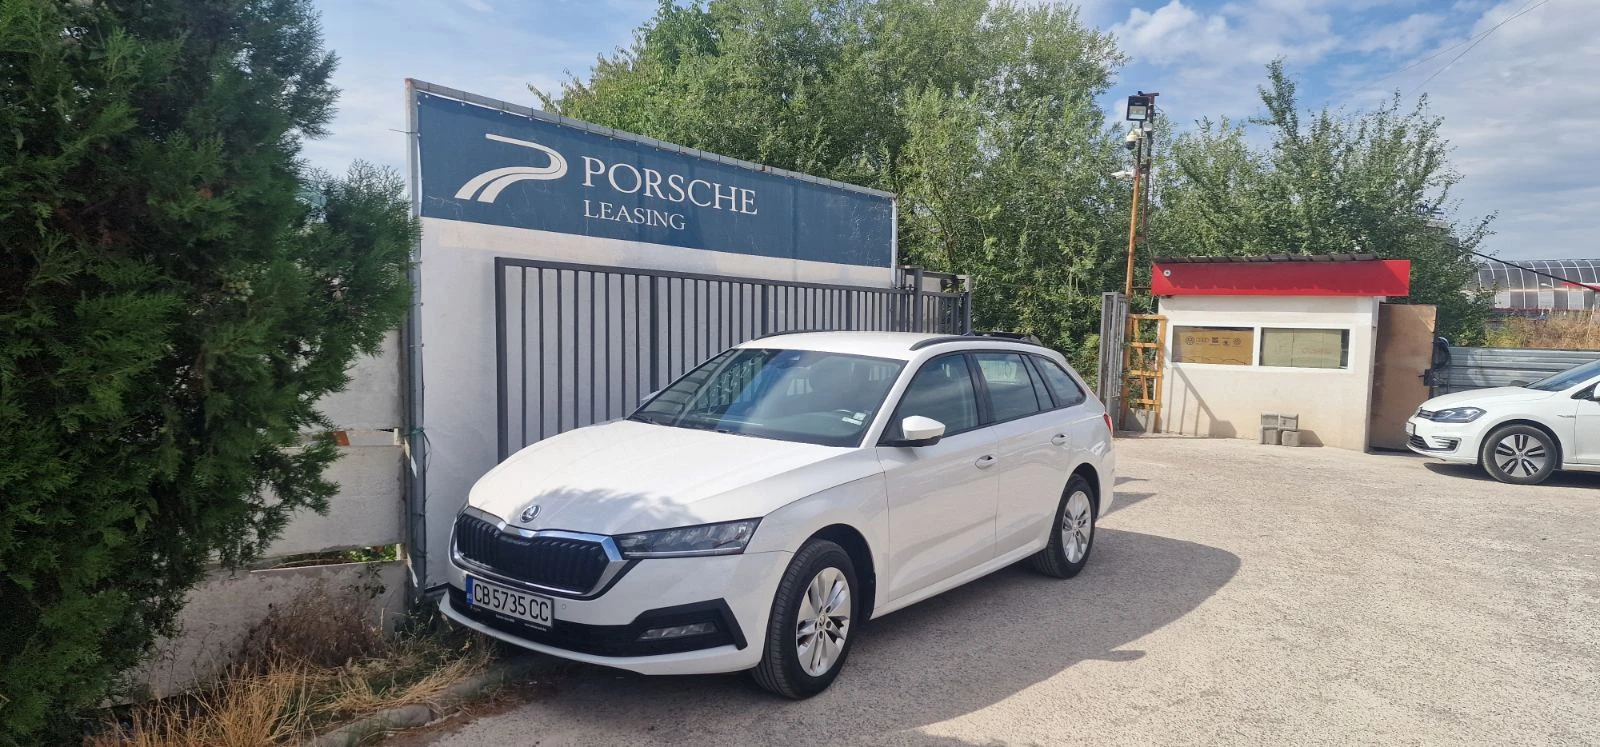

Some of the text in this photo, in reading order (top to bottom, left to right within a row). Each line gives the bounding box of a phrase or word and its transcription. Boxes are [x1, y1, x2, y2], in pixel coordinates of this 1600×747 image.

[581, 155, 759, 216] PORSCHE
[583, 199, 687, 231] LEASING
[474, 583, 549, 622] CB 5735 CC
